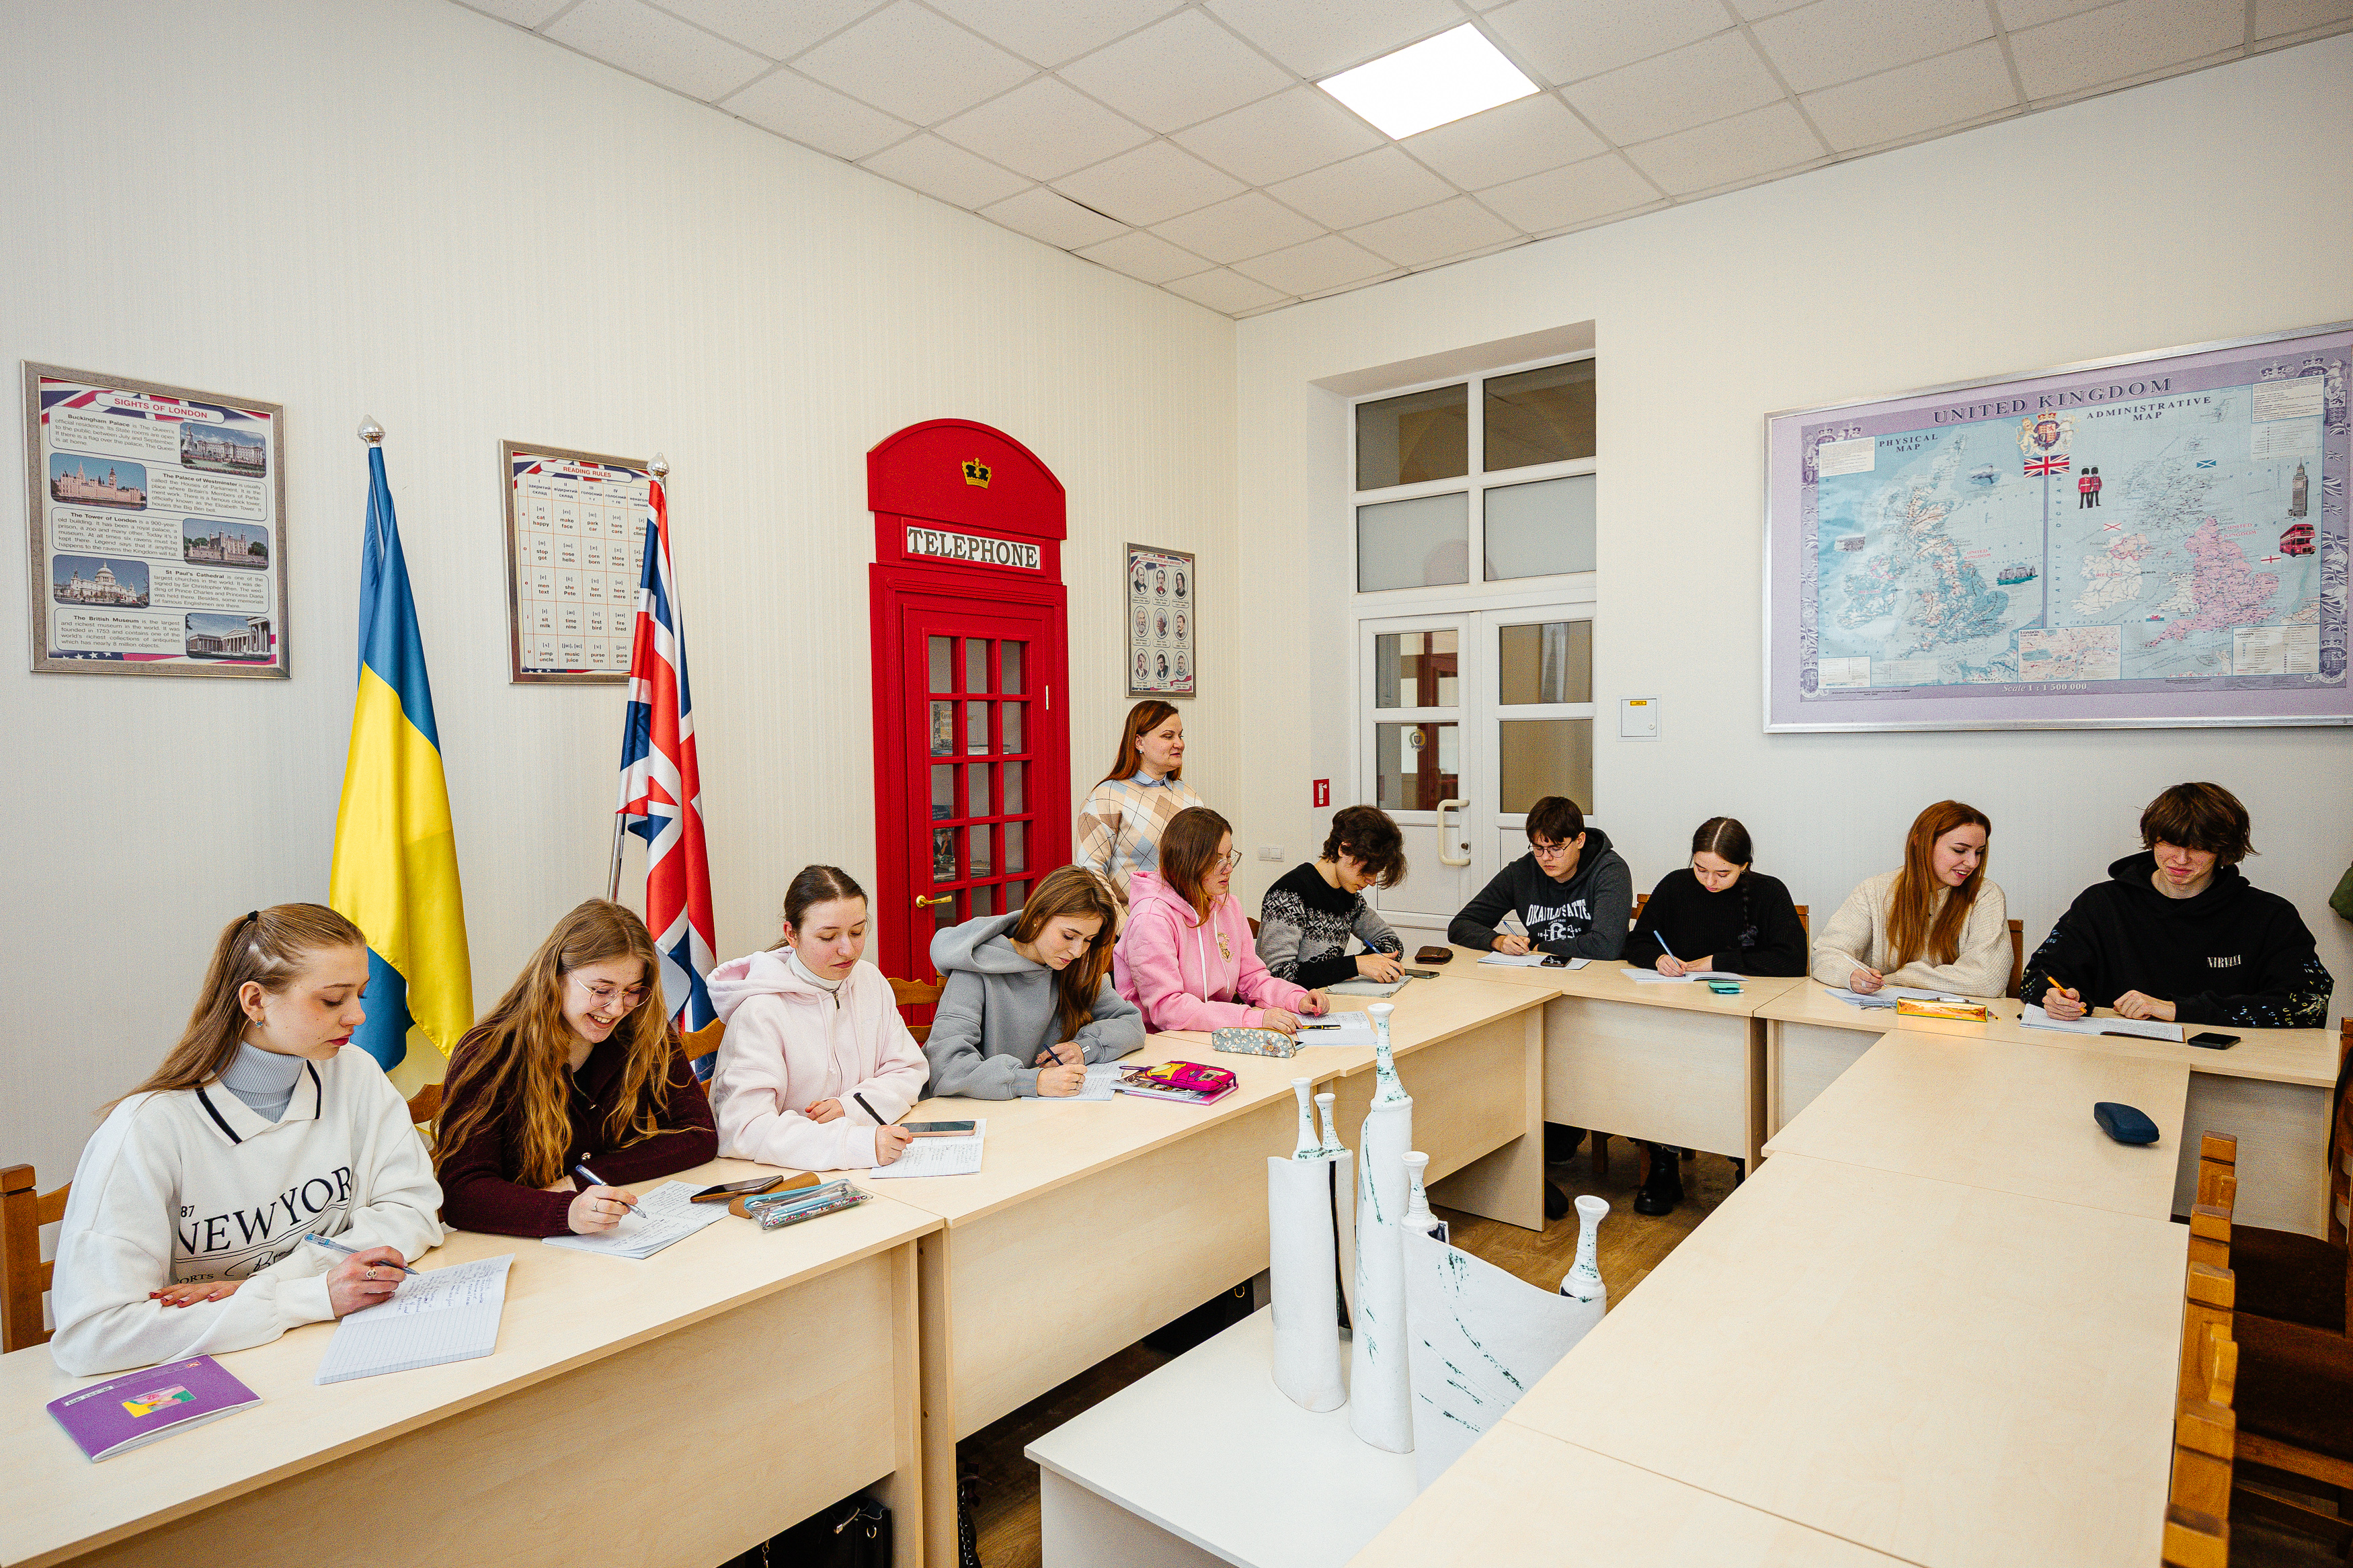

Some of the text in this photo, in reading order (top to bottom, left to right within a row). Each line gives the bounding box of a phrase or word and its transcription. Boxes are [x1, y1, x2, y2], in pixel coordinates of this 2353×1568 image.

[1934, 377, 2172, 423] UNITED KINGDOM
[114, 398, 149, 409] SIGHTS
[169, 407, 207, 418] LONDON
[2087, 397, 2211, 419] ADMINISTRATIVE
[68, 414, 107, 424] Buckingham
[2133, 412, 2162, 421] MAP
[1879, 434, 1937, 447] PHYSICAL
[1897, 444, 1920, 452] MAP
[563, 466, 590, 475] READING
[908, 528, 1037, 568] TELEPHONE
[180, 1205, 195, 1217] 87
[177, 1274, 214, 1284] ORTS
